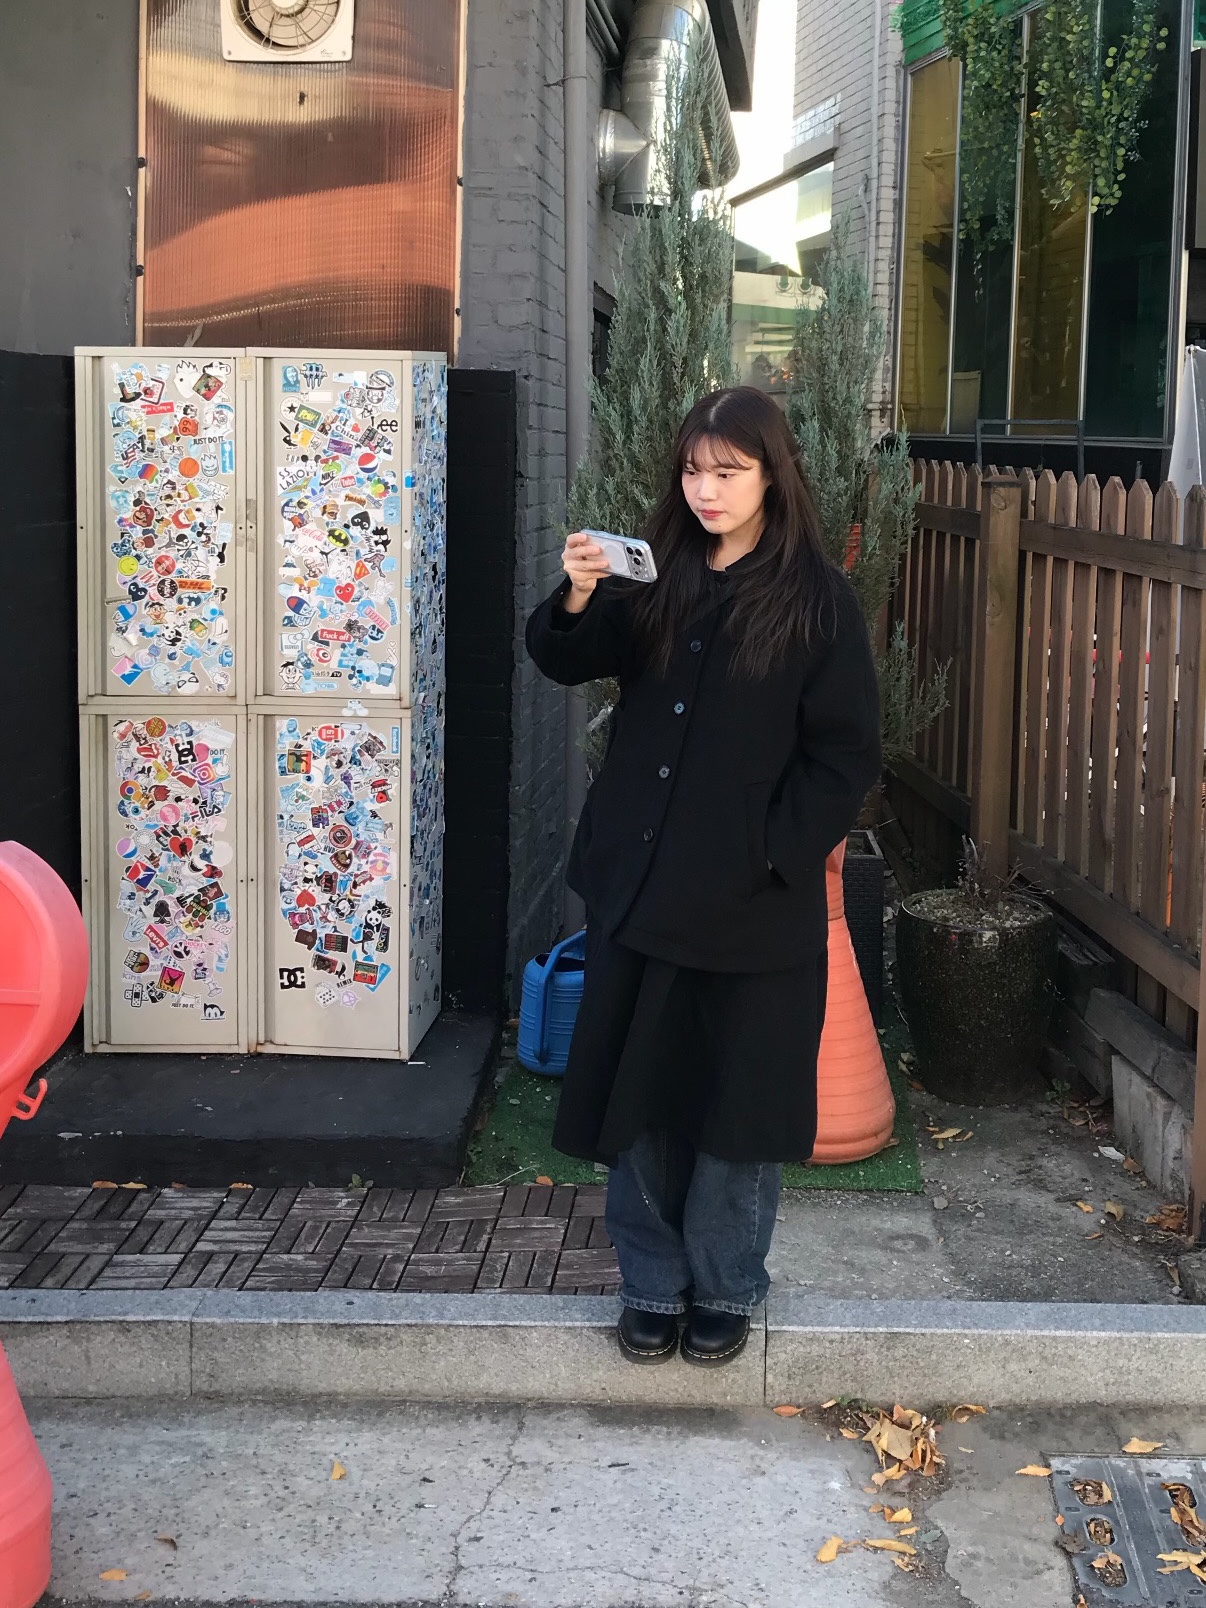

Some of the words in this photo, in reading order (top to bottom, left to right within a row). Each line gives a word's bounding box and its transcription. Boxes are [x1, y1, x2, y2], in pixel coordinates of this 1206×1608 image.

[193, 437, 207, 445] JUST
[279, 469, 306, 491] LAZIO
[321, 471, 336, 481] NIKE
[178, 581, 207, 589] DHL
[322, 632, 338, 640] Fuck
[190, 804, 222, 822] FILA
[211, 922, 232, 935] LEGO
